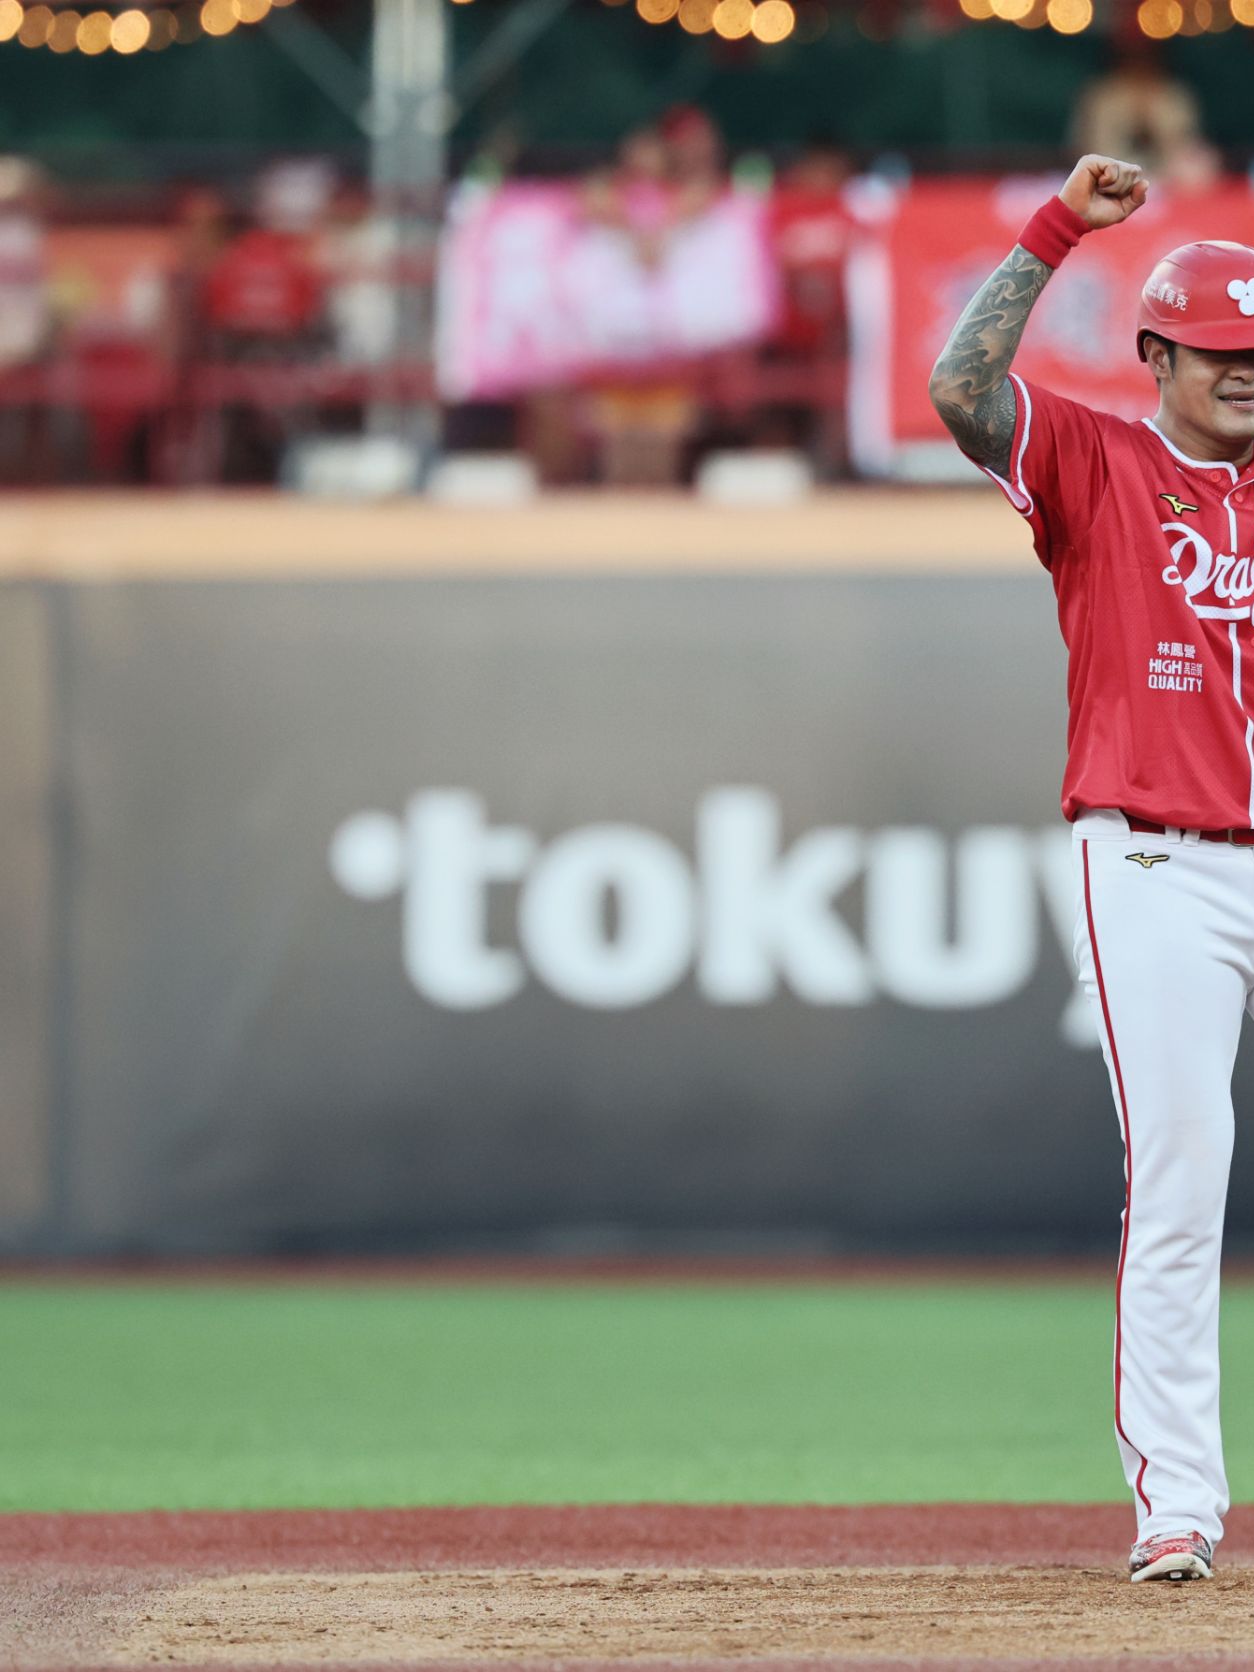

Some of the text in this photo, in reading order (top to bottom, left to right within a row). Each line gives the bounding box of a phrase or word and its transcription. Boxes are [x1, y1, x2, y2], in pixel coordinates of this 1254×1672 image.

[1157, 641, 1196, 659] 林鳳營
[1149, 658, 1182, 675] HIGH
[1148, 674, 1203, 693] QUALITY
